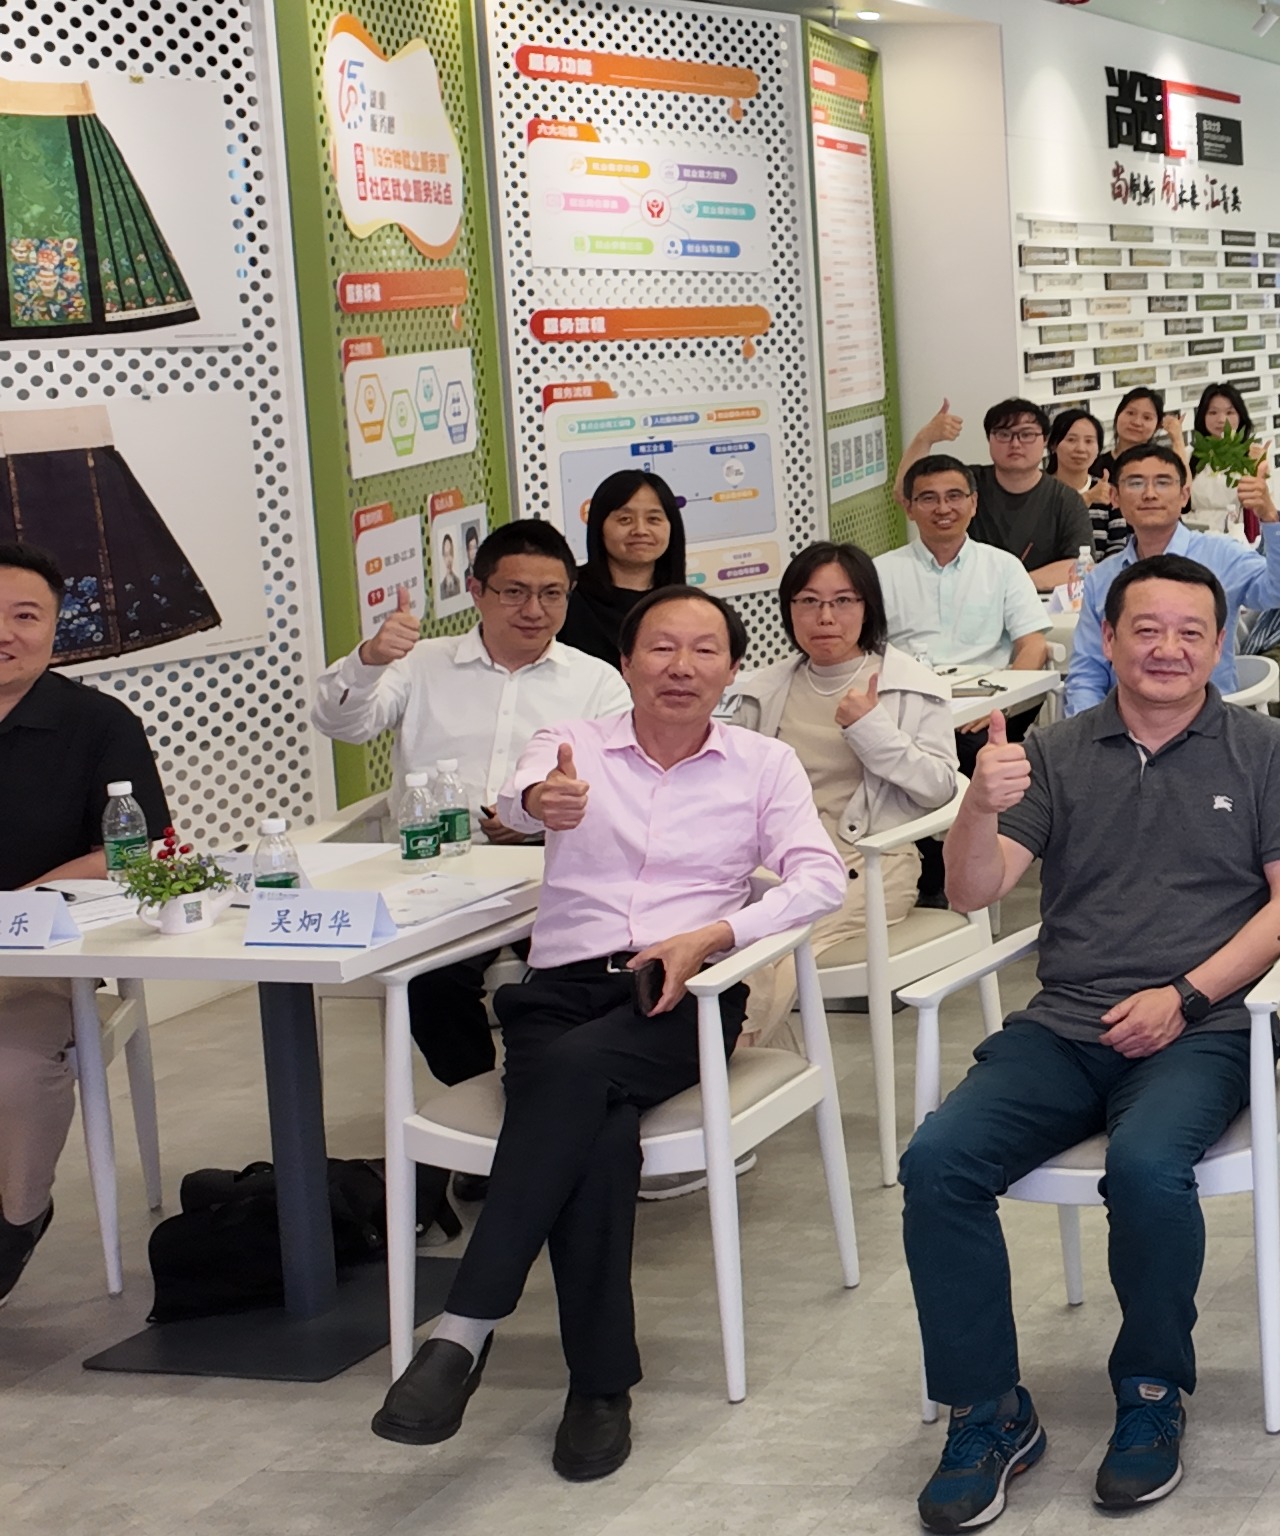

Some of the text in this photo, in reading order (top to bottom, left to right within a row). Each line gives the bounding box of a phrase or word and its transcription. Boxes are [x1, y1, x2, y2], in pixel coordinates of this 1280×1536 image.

[528, 53, 593, 76] 服务功能
[369, 177, 453, 205] 社区就业服务站点
[543, 316, 606, 335] 服务流程
[553, 386, 593, 400] 服务流程
[0, 911, 30, 937] 乐
